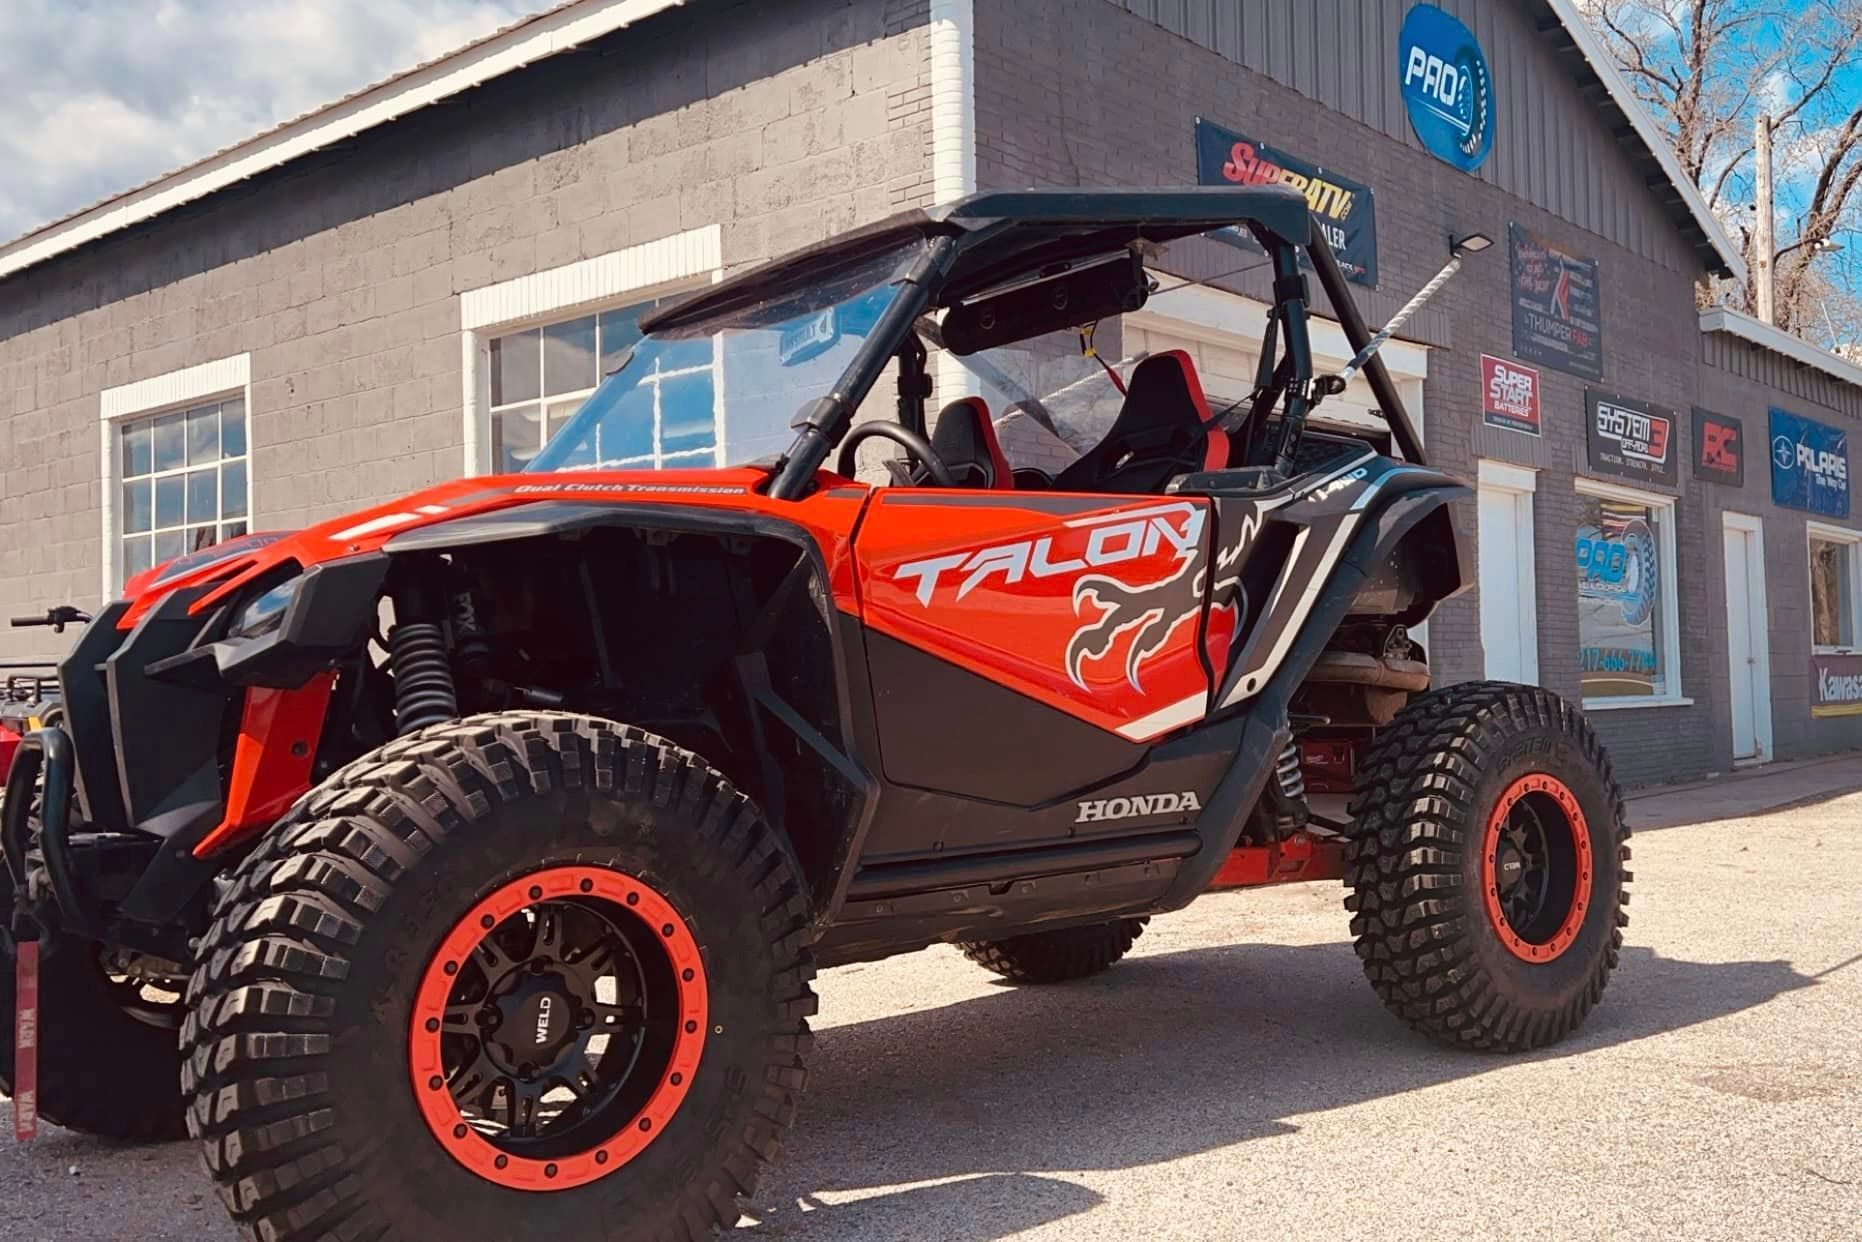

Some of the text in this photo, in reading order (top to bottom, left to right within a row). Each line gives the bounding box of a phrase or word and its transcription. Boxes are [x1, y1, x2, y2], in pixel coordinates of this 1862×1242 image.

[1490, 377, 1533, 407] START
[1495, 364, 1532, 391] SUPER
[1598, 405, 1650, 441] SYSTEM
[1796, 443, 1847, 480] POLARIS
[514, 483, 745, 495] Dual Clutch Transmission
[893, 504, 1206, 608] TALON
[1075, 791, 1201, 822] HONDA
[18, 1008, 35, 1049] WARN
[536, 997, 551, 1043] WELD
[18, 1090, 35, 1132] WARN
